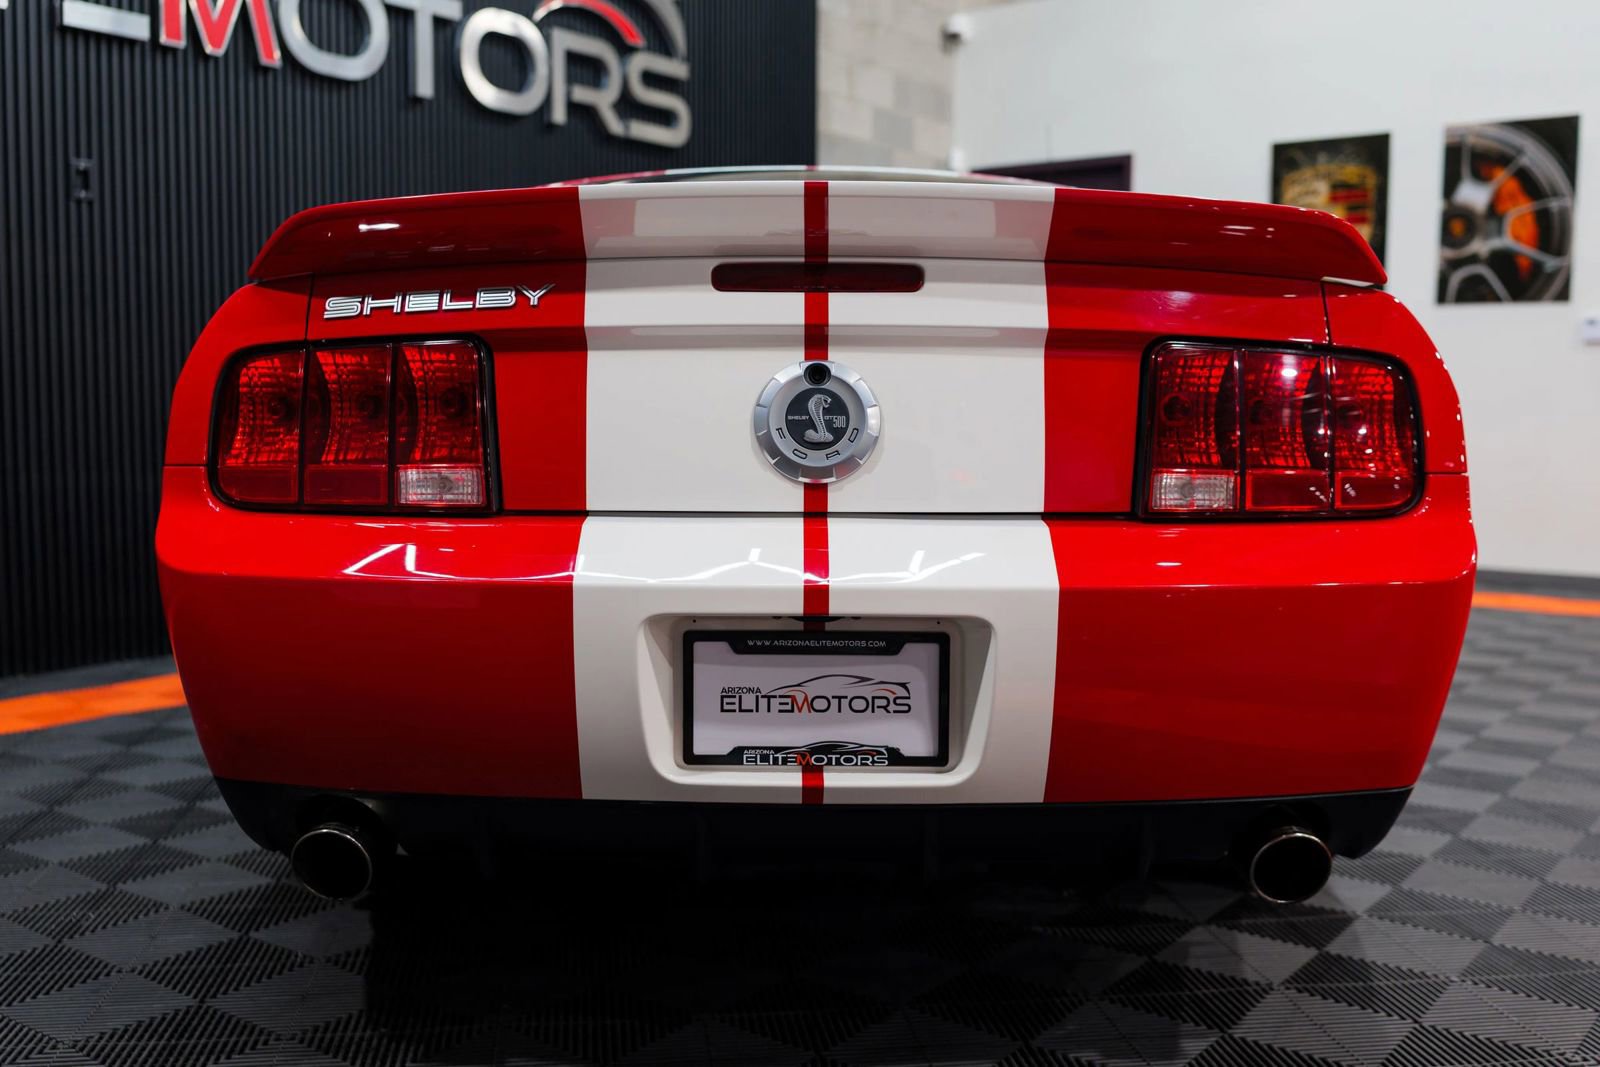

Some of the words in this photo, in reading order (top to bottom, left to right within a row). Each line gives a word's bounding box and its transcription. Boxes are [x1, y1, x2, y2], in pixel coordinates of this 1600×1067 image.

[323, 284, 555, 318] SHELBY
[776, 427, 859, 460] FORD
[720, 686, 762, 695] ARIZONA
